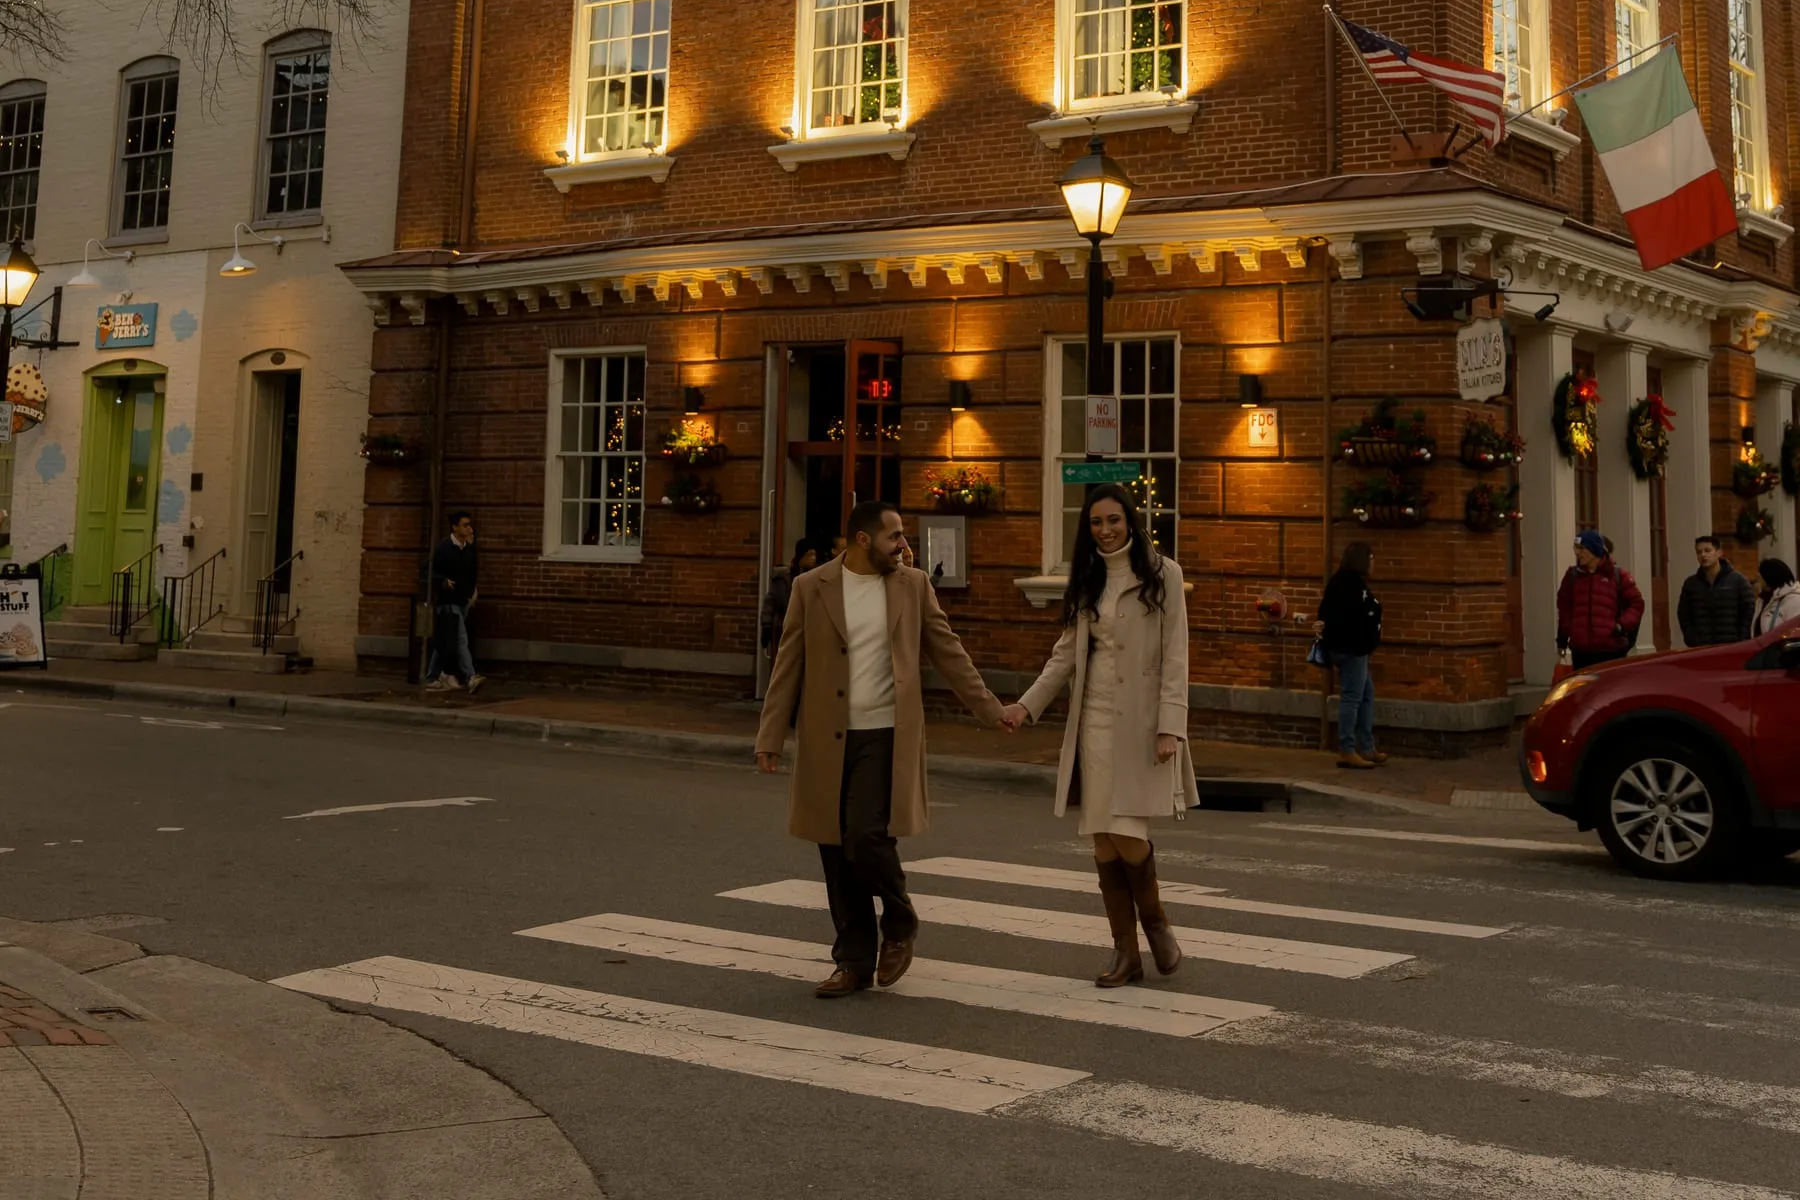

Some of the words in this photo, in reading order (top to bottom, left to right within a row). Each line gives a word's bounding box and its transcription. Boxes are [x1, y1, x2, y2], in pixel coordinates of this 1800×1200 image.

[114, 313, 134, 326] BEN
[112, 323, 150, 339] JERRY'S
[1096, 403, 1109, 416] NO
[1088, 416, 1117, 429] PARKING
[1251, 413, 1274, 427] FDC
[0, 592, 28, 603] HT
[0, 603, 29, 612] STUFF
